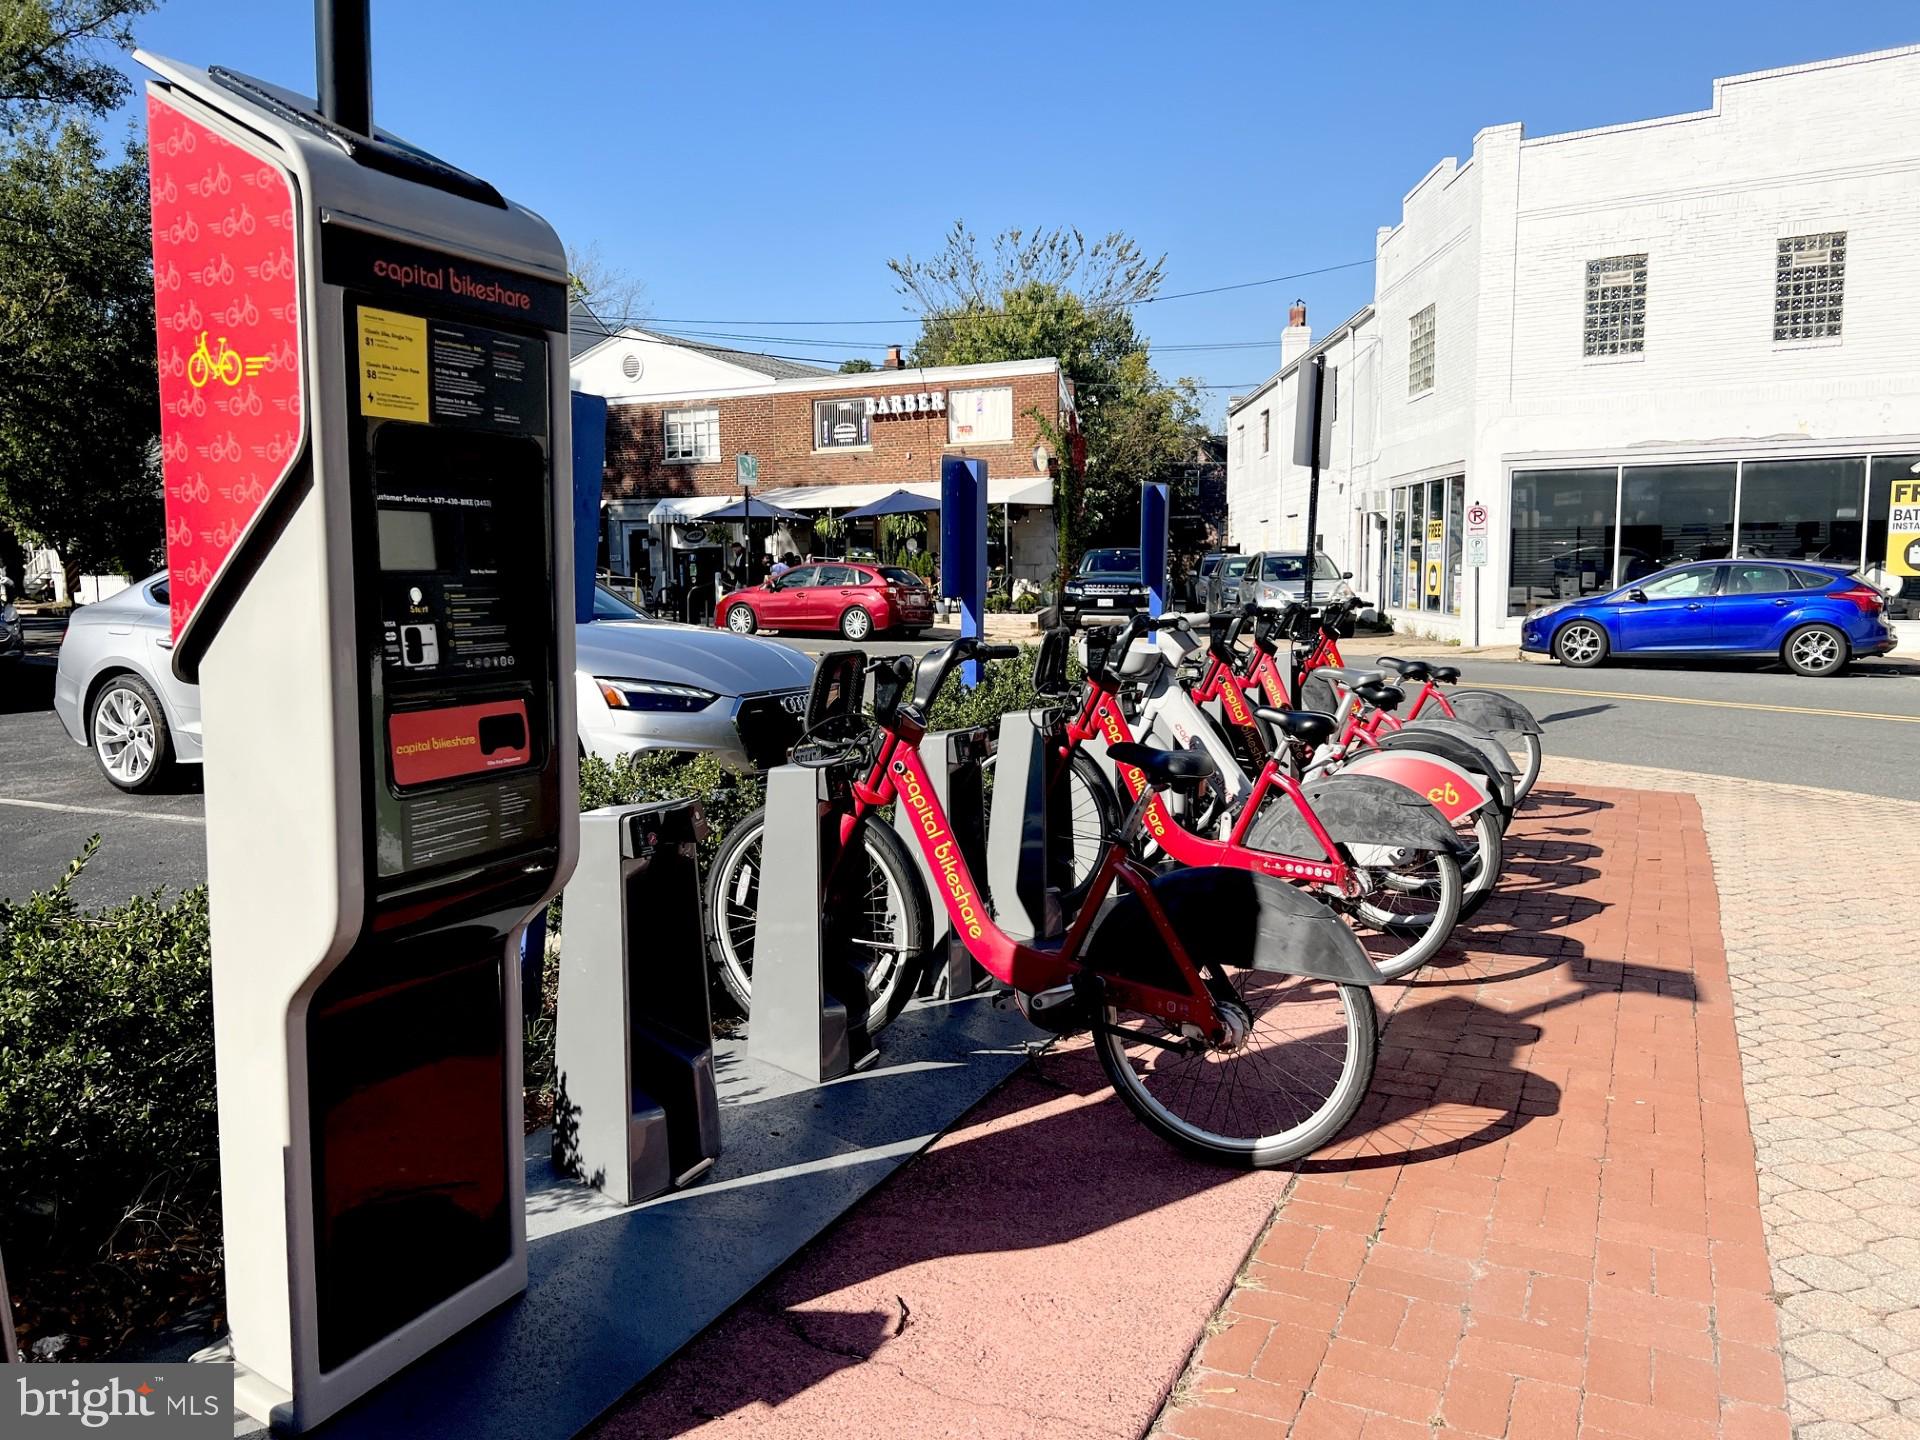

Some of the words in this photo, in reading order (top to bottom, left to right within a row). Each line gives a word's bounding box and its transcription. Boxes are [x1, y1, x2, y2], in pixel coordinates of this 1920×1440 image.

[374, 260, 443, 290] capital
[450, 267, 530, 310] bikeshare
[365, 336, 374, 346] $1
[366, 369, 377, 380] $8
[865, 392, 945, 414] BARBER
[1428, 523, 1442, 538] FREE
[1222, 681, 1248, 721] capital
[396, 741, 431, 756] capital
[431, 736, 476, 750] bikeshare
[903, 770, 944, 840] capital
[934, 840, 982, 940] bikeshare
